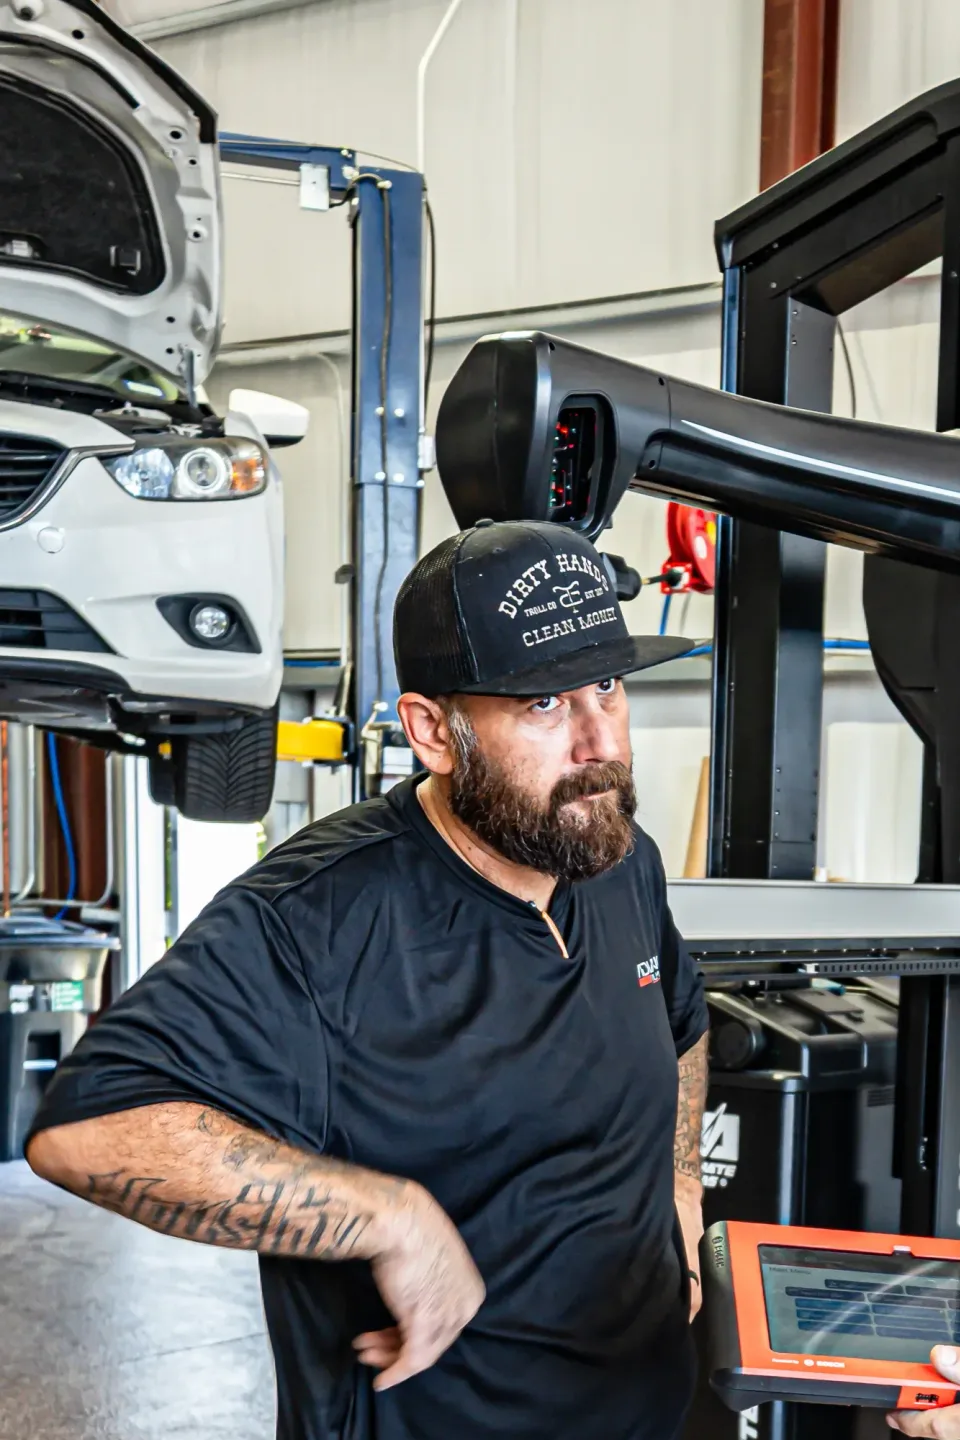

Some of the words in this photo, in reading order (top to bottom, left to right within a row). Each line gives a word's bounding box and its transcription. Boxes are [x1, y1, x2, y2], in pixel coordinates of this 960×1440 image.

[498, 559, 551, 619] DIRTY
[555, 554, 609, 592] HANDS
[547, 601, 557, 611] CO
[522, 618, 576, 647] CLEAN
